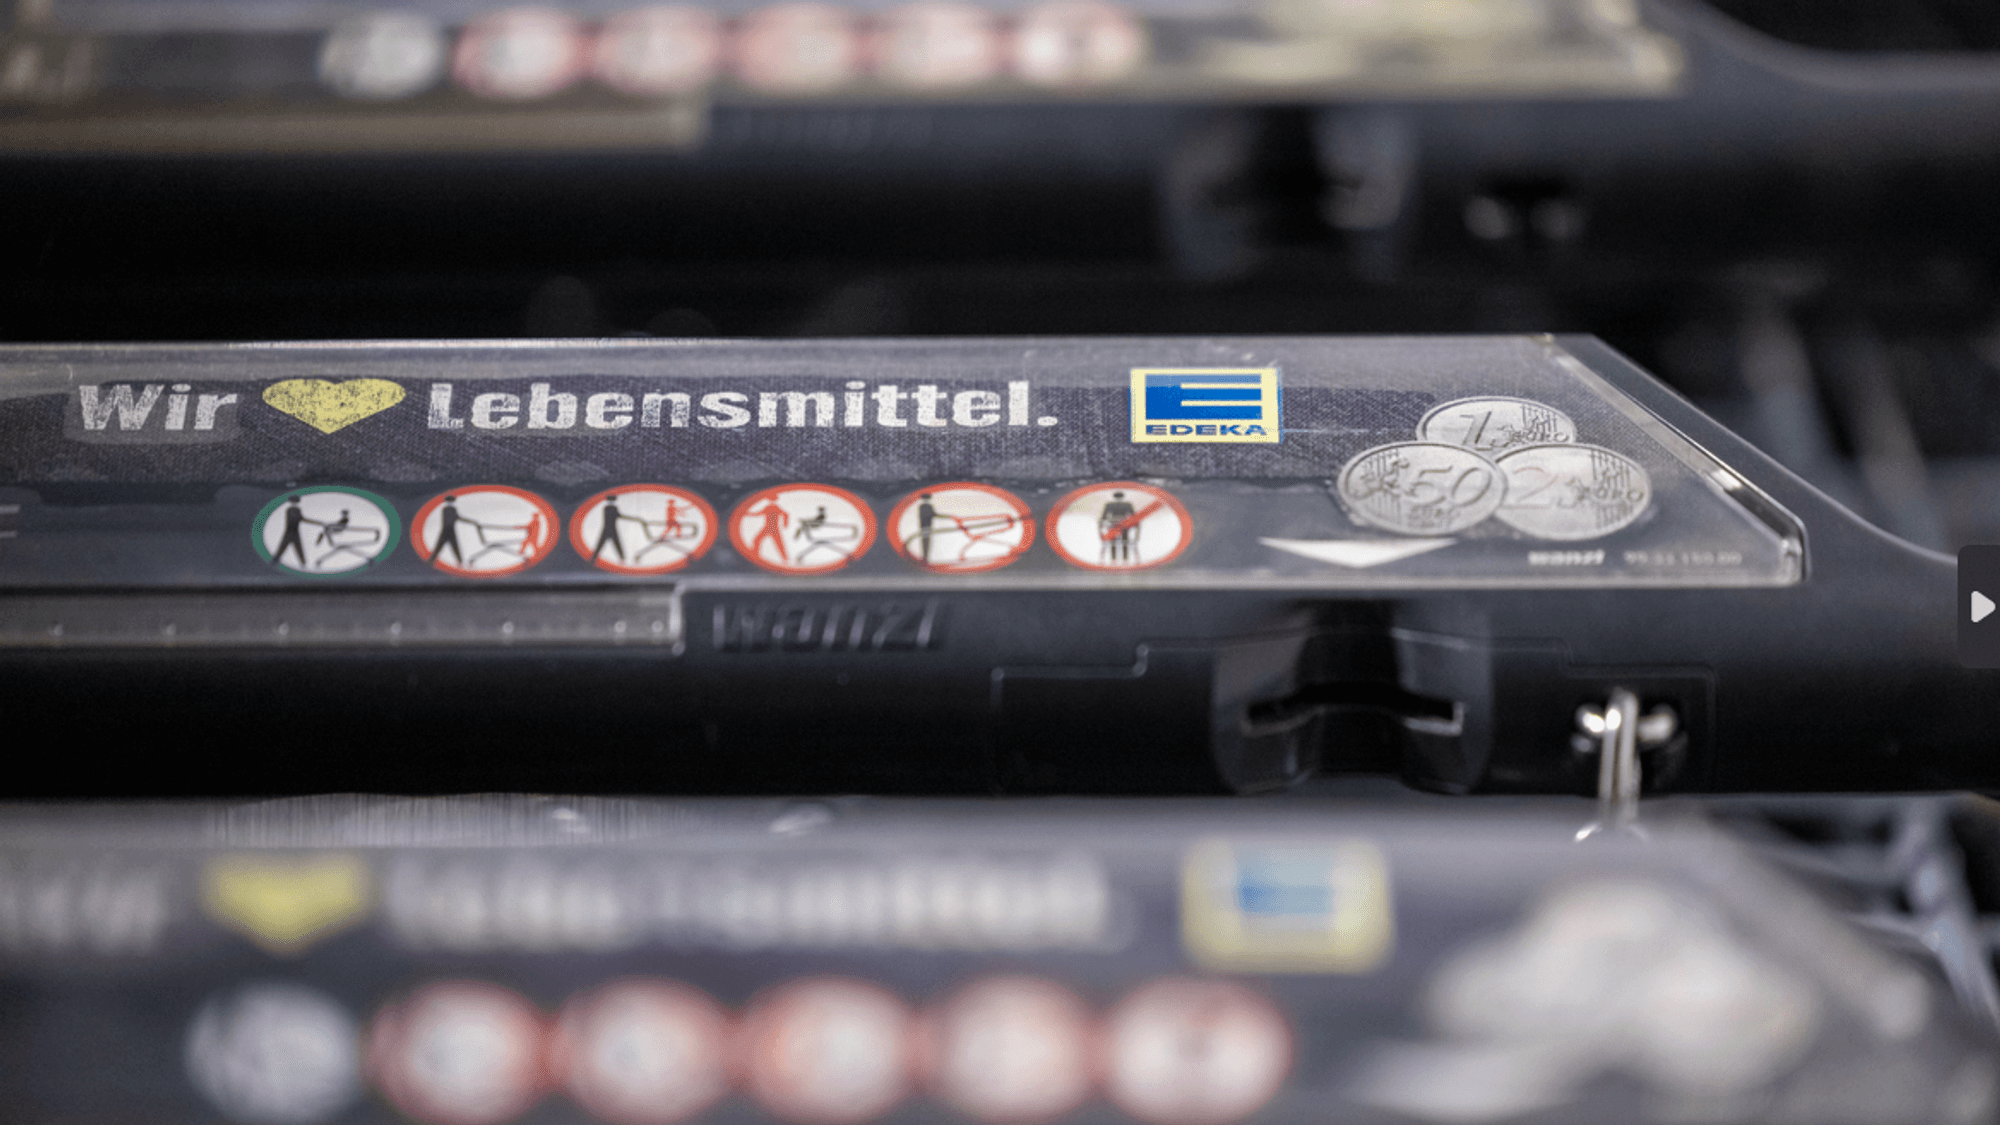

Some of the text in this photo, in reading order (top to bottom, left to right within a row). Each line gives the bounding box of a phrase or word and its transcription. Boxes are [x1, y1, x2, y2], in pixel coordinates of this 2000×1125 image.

[79, 380, 1058, 430] Wir Lebensmittel.
[1145, 424, 1267, 436] EDEKA
[1409, 465, 1491, 509] 50
